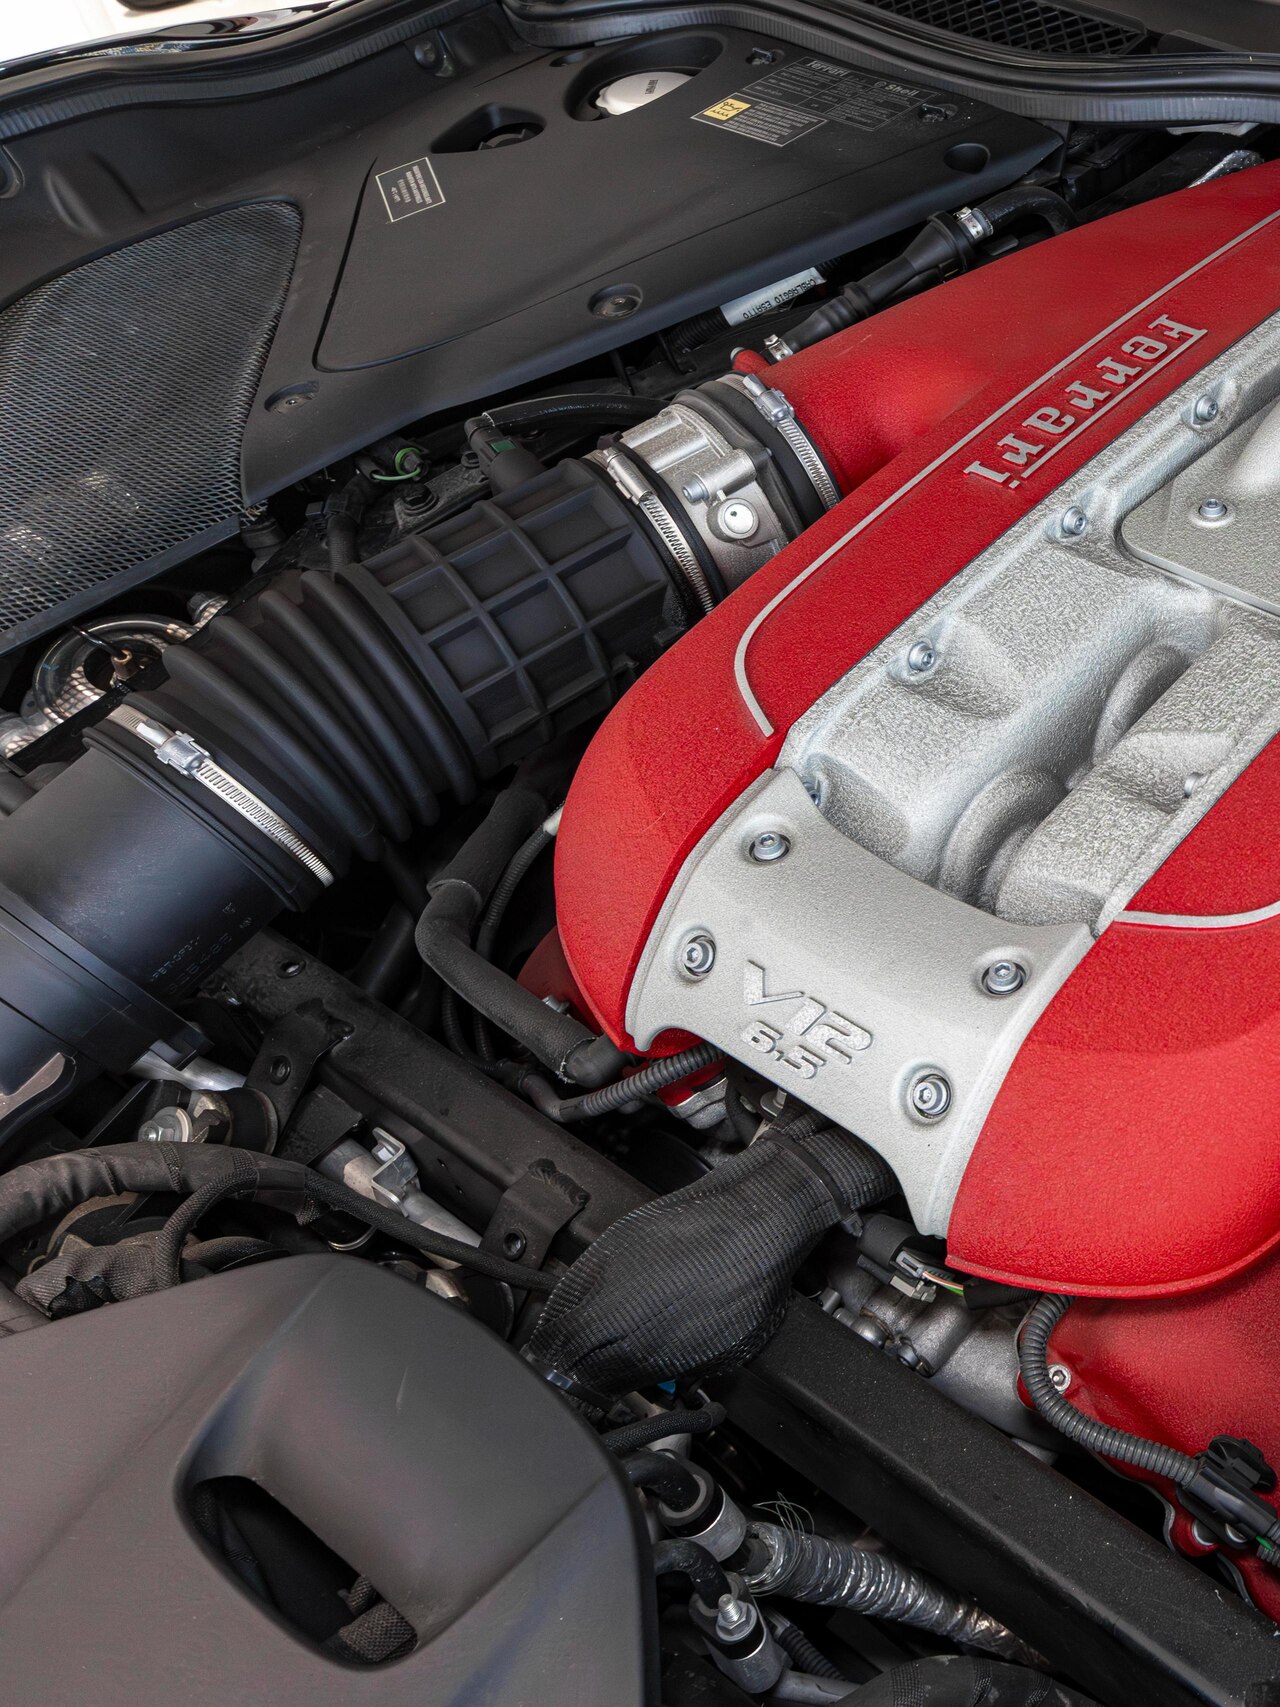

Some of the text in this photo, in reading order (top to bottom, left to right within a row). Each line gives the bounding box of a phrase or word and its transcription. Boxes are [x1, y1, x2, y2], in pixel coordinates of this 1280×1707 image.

[806, 59, 849, 77] Ferrari
[885, 84, 920, 97] Shell
[742, 278, 816, 320] CABLAGGIO ESATTO
[963, 314, 1208, 489] Ferrari
[742, 958, 873, 1065] V12
[740, 1020, 828, 1080] 6.5
